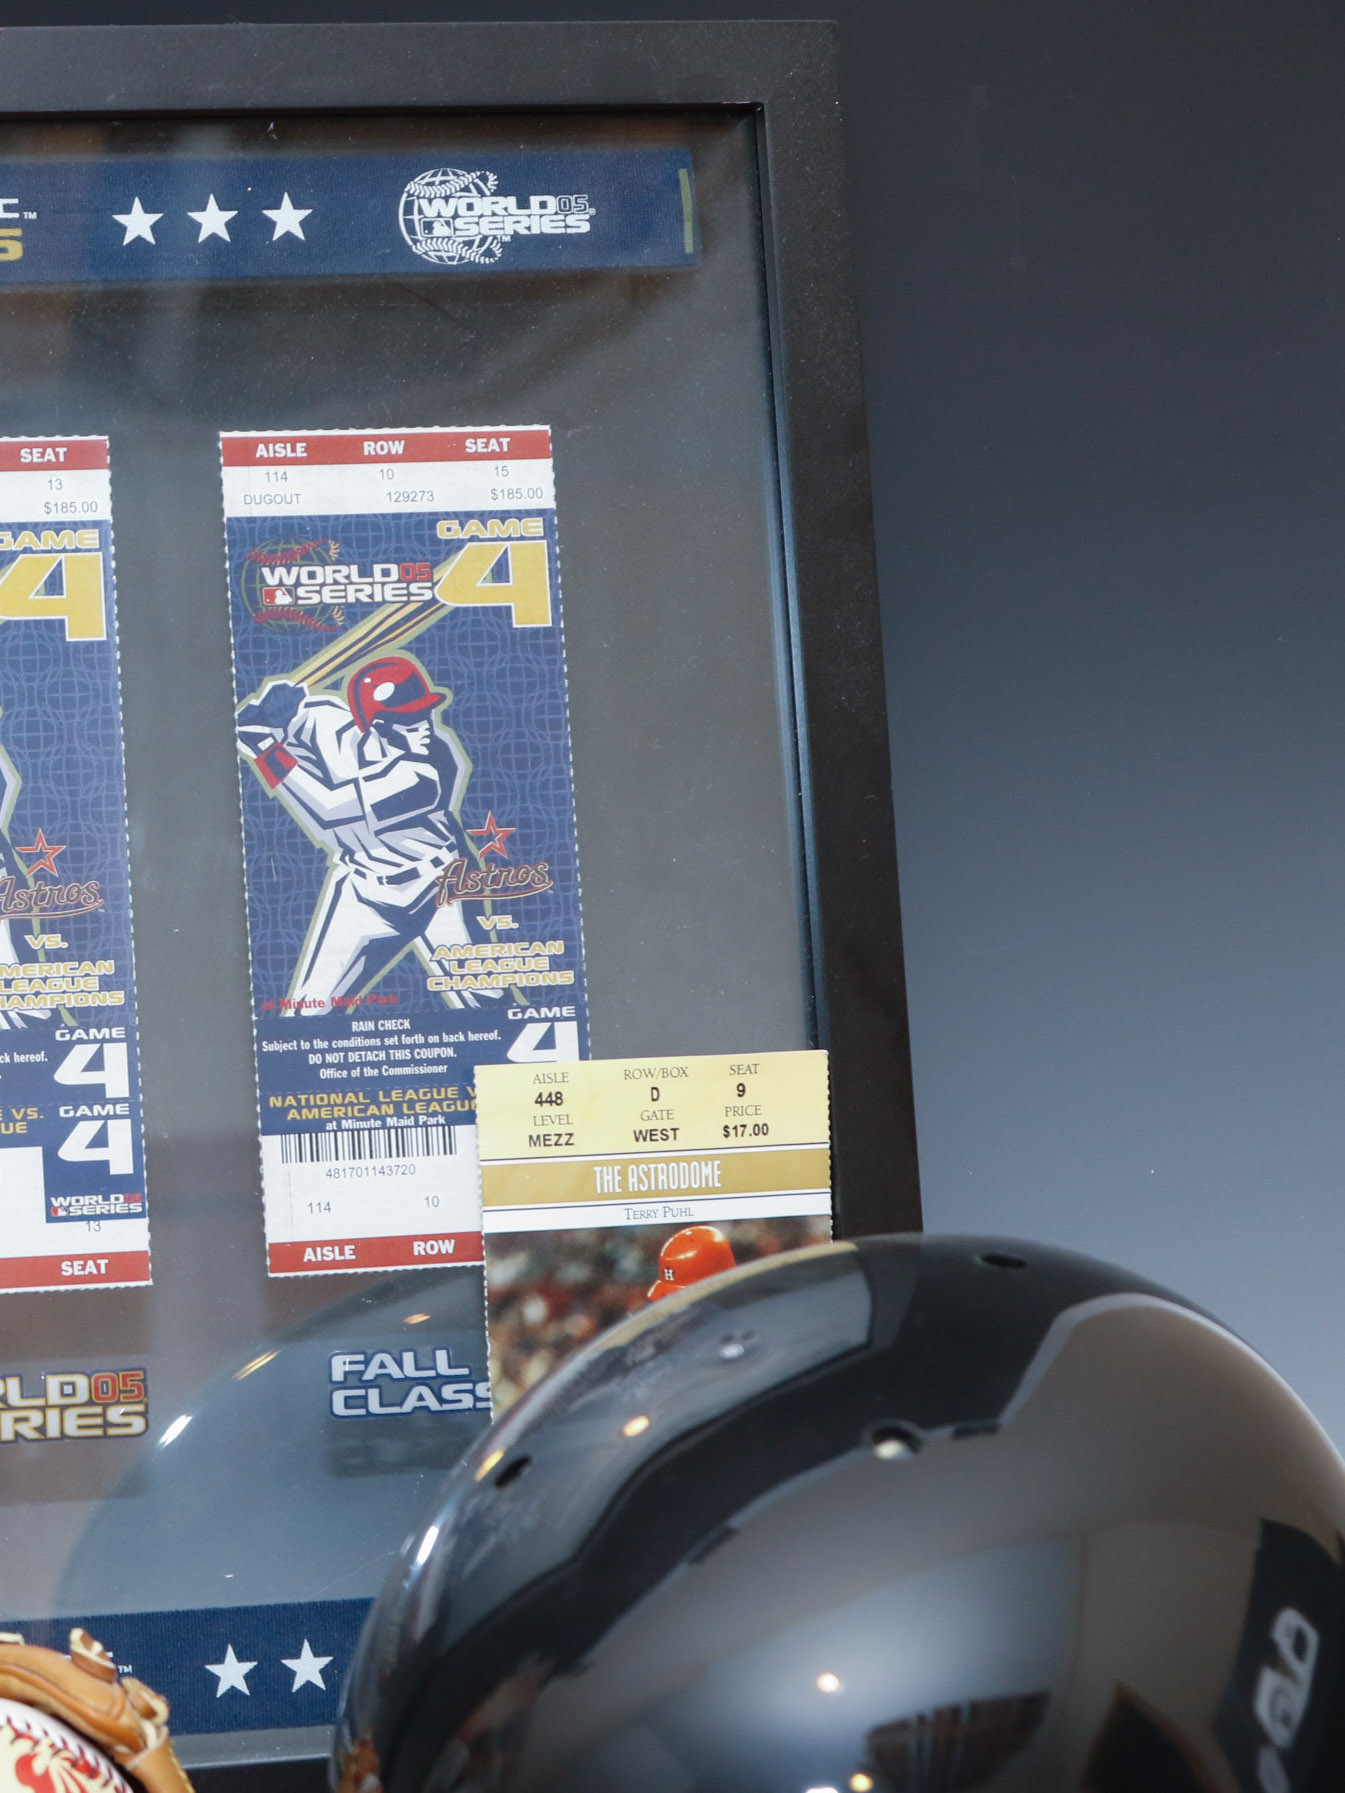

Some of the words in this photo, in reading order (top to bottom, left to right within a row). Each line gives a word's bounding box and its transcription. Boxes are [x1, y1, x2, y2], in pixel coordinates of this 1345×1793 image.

[418, 194, 557, 218] WORLD
[454, 213, 591, 236] SERIES
[20, 447, 68, 463] SEAT
[255, 442, 307, 458] AISLE
[363, 440, 405, 456] ROW
[464, 438, 511, 453] SEAT
[264, 471, 288, 483] 114
[378, 468, 395, 480] 10
[494, 465, 510, 478] 15
[47, 478, 64, 491] 13
[243, 493, 302, 506] DUGOUT
[385, 490, 435, 503] 129273
[490, 487, 544, 502] $185.00
[43, 500, 99, 515] $185.00
[436, 517, 544, 539] GAME
[261, 563, 399, 586] WORLD
[399, 561, 433, 582] 05
[296, 581, 433, 605] SERIES
[434, 539, 553, 628] 4
[435, 857, 554, 909] Astros
[475, 914, 519, 931] VS.
[24, 933, 69, 949] VS.
[431, 940, 565, 961] AMERICAN
[449, 956, 550, 975] LEAGUE
[426, 970, 575, 992] CHAMPIONS
[279, 997, 326, 1011] Minute
[330, 995, 364, 1009] Maid
[367, 993, 399, 1006] Park
[507, 1006, 576, 1020] GAME
[55, 1027, 126, 1041] GAME
[351, 1021, 376, 1033] RAIN
[378, 1019, 411, 1031] CHECK
[262, 1040, 299, 1053] Subject
[301, 1040, 311, 1050] to
[313, 1038, 330, 1049] the
[332, 1037, 382, 1049] conditions
[384, 1036, 399, 1046] set
[401, 1034, 425, 1045] forth
[442, 1032, 465, 1043] back
[468, 1030, 502, 1042] hereof.
[507, 1020, 580, 1063] 4
[13, 1051, 49, 1063] hereof.
[308, 1054, 323, 1065] DO
[325, 1053, 345, 1064] NOT
[348, 1050, 386, 1062] DETACH
[389, 1049, 412, 1060] THIS
[414, 1046, 458, 1059] COUPON.
[53, 1042, 130, 1099] 4
[319, 1067, 349, 1079] Office
[363, 1065, 380, 1076] the
[382, 1063, 448, 1076] Commissioner
[532, 1071, 570, 1086] AISLE
[623, 1066, 689, 1081] ROW/BOX
[729, 1063, 761, 1077] SEAT
[269, 1092, 371, 1108] NATIONAL
[378, 1087, 459, 1102] LEAGUE
[534, 1091, 564, 1107] 448
[650, 1086, 661, 1102] D
[736, 1083, 746, 1098] 9
[10, 1107, 45, 1120] VS.
[58, 1103, 131, 1118] GAME
[287, 1104, 395, 1121] AMERICAN
[533, 1113, 574, 1127] LEVEL
[640, 1109, 675, 1122] GATE
[724, 1104, 762, 1118] PRICE
[325, 1121, 338, 1131] at
[341, 1118, 382, 1130] Minute
[386, 1116, 415, 1127] Maid
[418, 1114, 446, 1126] Park
[528, 1132, 575, 1148] MEZZ
[633, 1128, 680, 1144] WEST
[722, 1123, 770, 1139] $17.00
[57, 1119, 134, 1175] 4
[325, 1163, 416, 1179] 481701143720
[593, 1165, 623, 1194] THE
[628, 1160, 722, 1192] ASTRODOME
[50, 1193, 125, 1207] WORLD
[69, 1203, 143, 1216] SERIES
[307, 1201, 332, 1214] 114
[423, 1195, 440, 1208] 10
[86, 1220, 102, 1233] 13
[303, 1245, 356, 1262] AISLE
[412, 1239, 456, 1256] ROW
[60, 1259, 109, 1276] SEAT
[330, 1349, 470, 1382] FALL
[90, 1370, 148, 1404] 05
[331, 1381, 492, 1416] CLASS
